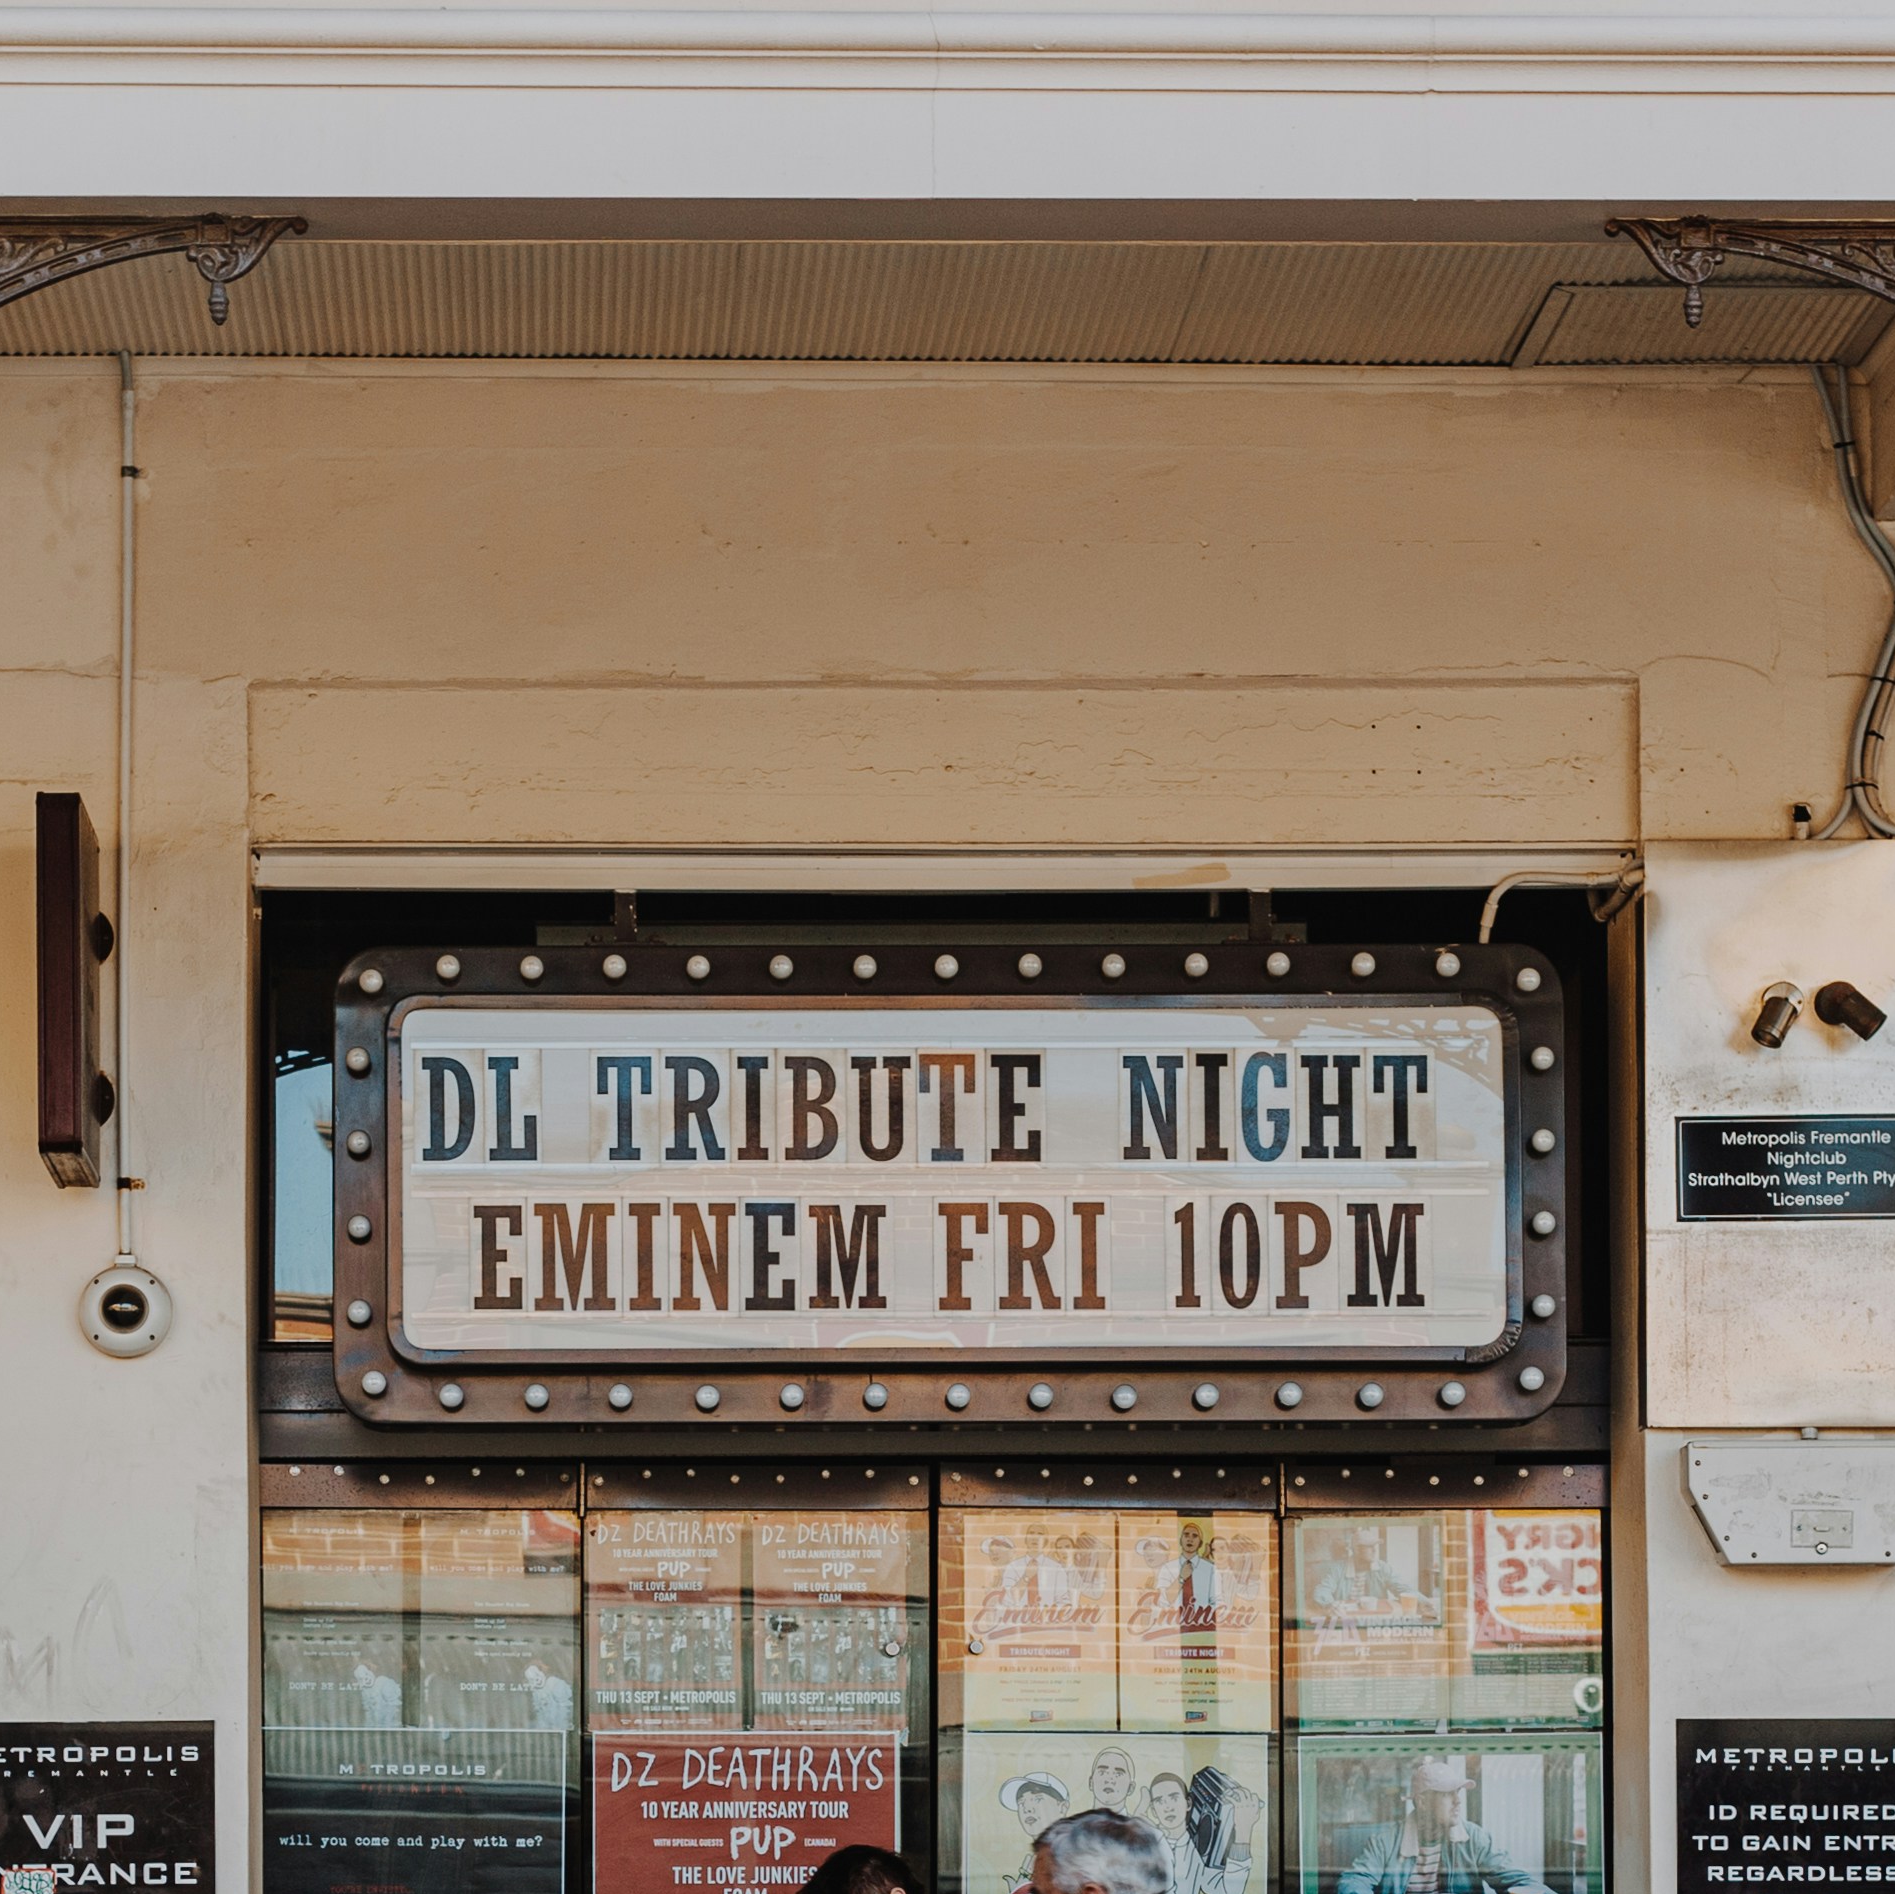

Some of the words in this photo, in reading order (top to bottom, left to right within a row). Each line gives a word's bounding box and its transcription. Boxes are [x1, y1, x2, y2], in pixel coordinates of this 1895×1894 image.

[422, 1054, 540, 1163] DL
[596, 1052, 1044, 1164] TRIBUTE
[1123, 1051, 1429, 1163] NIGHT
[1722, 1131, 1806, 1146] Metropolis
[1811, 1130, 1891, 1144] Fremantle
[1767, 1151, 1846, 1167] Nightclub
[1688, 1171, 1780, 1187] Strathalbyn
[1784, 1171, 1822, 1185] West
[1827, 1171, 1868, 1185] Perth
[473, 1201, 888, 1312] EMINEM
[938, 1200, 1104, 1311] FRI
[1172, 1199, 1425, 1310] 10PM
[598, 1524, 621, 1545] DZ
[633, 1520, 735, 1545] DEATHRAYS
[971, 1590, 1105, 1636] Eminem
[1127, 1592, 1259, 1632] Eminem
[1165, 1649, 1198, 1657] TRIBUTE
[1200, 1649, 1225, 1657] NIGHT
[612, 1752, 658, 1792] DZ
[682, 1746, 884, 1792] DEATHRAYS
[641, 1801, 658, 1819] 10
[661, 1801, 699, 1819] YEAR
[702, 1801, 806, 1819] ANNIVERSARY
[810, 1801, 849, 1819] TOUR
[1709, 1805, 1737, 1821] ID
[22, 1813, 136, 1850] VIP
[280, 1834, 312, 1847] will
[321, 1837, 347, 1849] you
[355, 1836, 389, 1847] come
[397, 1835, 423, 1847] and
[431, 1835, 464, 1849] play
[474, 1835, 507, 1847] with
[516, 1835, 543, 1848] me?
[730, 1824, 796, 1860] PUP
[1692, 1835, 1729, 1851] TO
[1742, 1835, 1811, 1851] GAIN
[672, 1866, 702, 1884] THE
[707, 1866, 746, 1884] LOVE
[750, 1866, 818, 1884] JUNKIES
